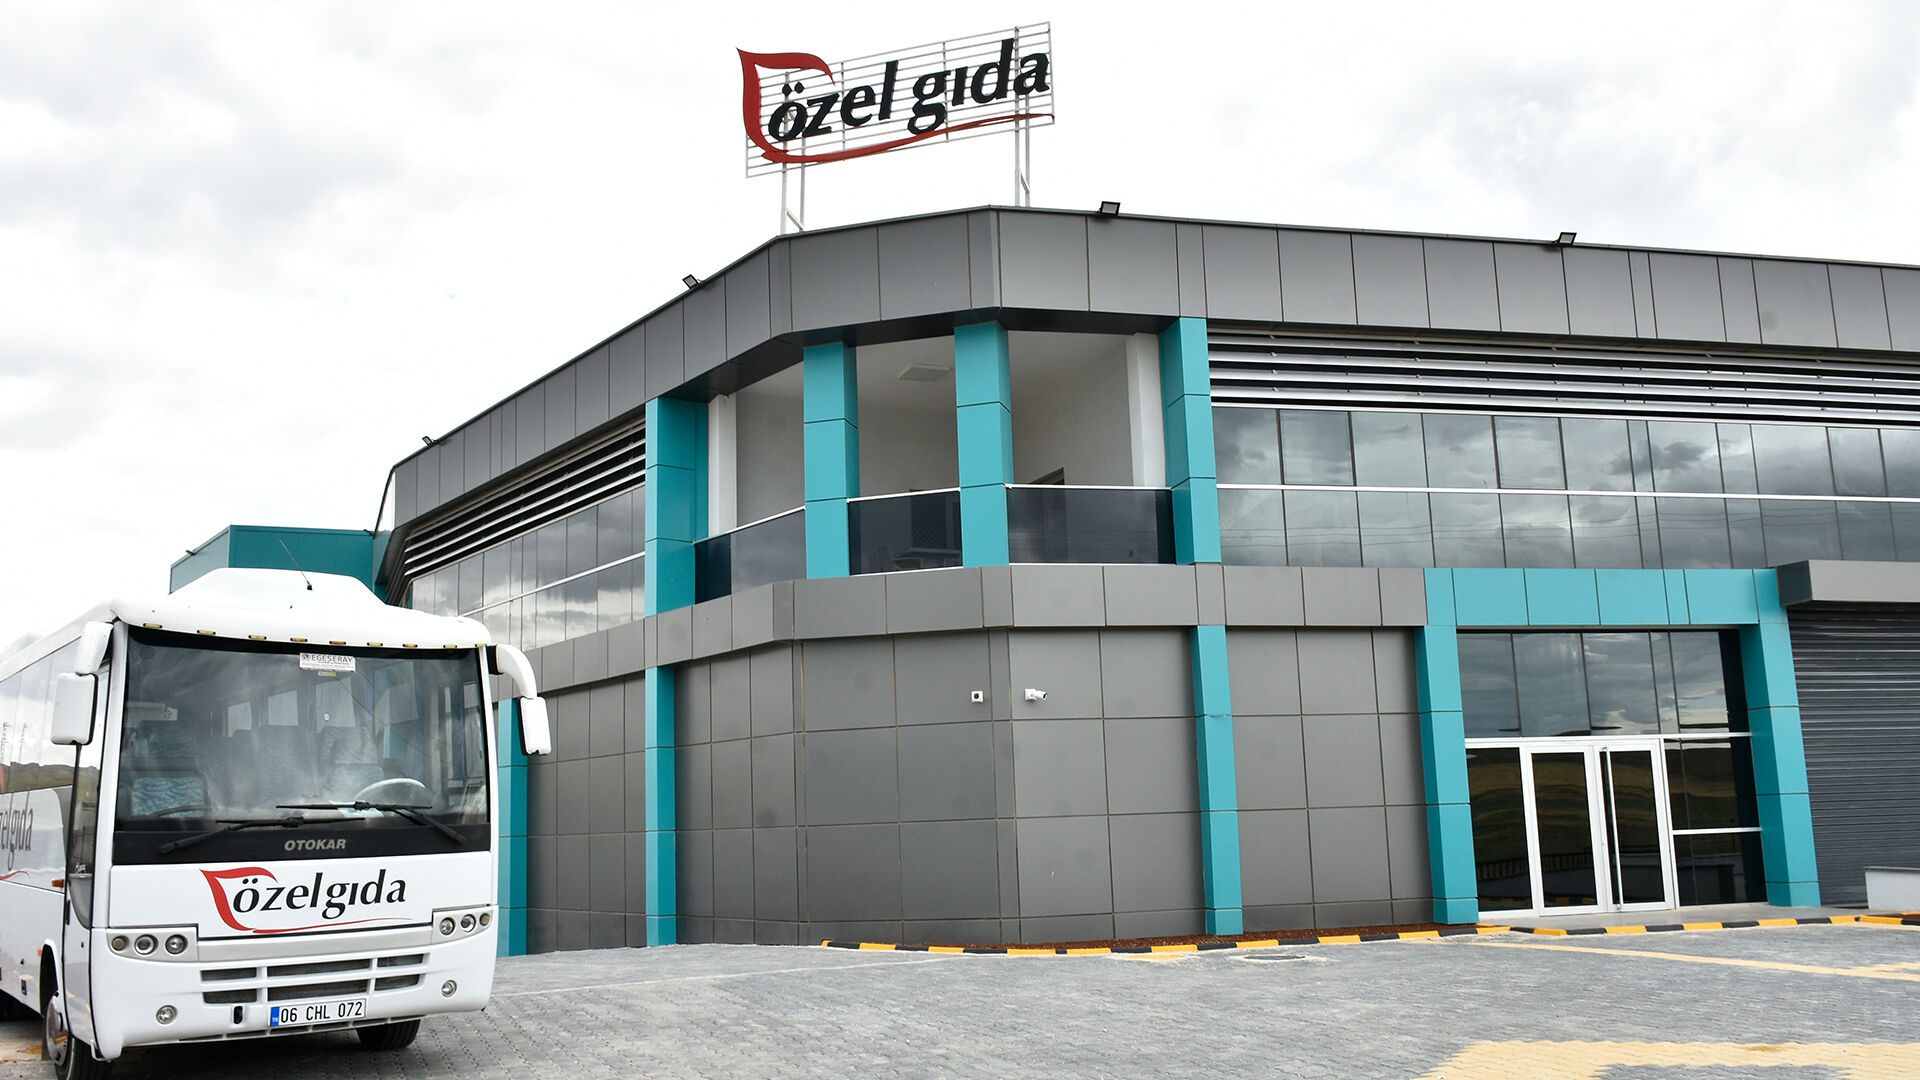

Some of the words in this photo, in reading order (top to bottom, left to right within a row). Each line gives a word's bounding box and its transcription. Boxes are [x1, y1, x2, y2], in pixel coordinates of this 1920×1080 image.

[768, 60, 898, 142] özel
[284, 839, 346, 851] OTOKAR
[281, 1008, 297, 1022] 06
[306, 1005, 330, 1021] CHL
[338, 1002, 362, 1018] 072
